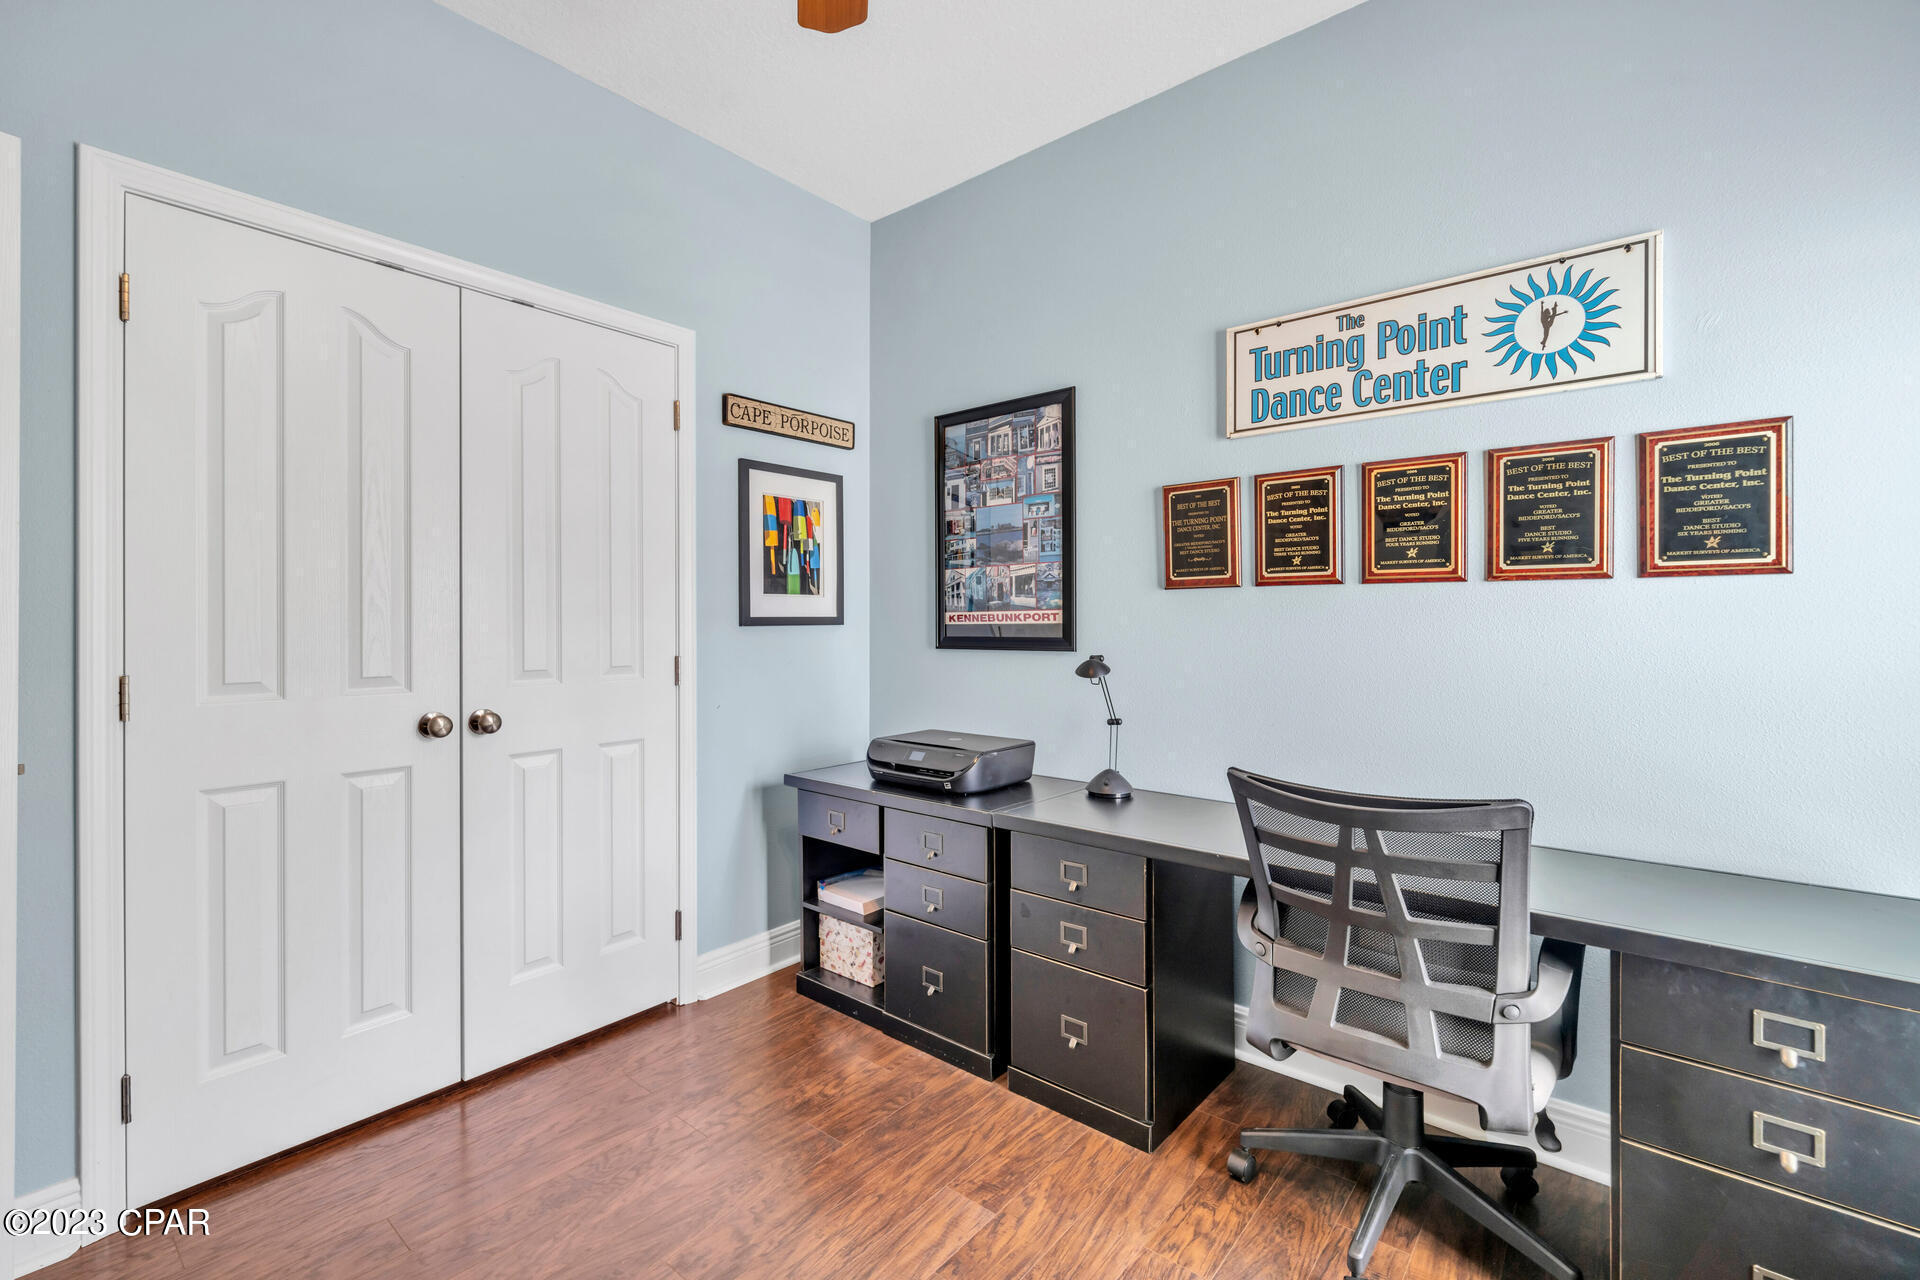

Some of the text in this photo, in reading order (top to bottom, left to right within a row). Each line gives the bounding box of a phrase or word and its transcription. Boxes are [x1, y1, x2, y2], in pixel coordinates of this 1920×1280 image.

[1336, 314, 1365, 332] The
[1249, 305, 1468, 383] Turning Point
[1251, 359, 1468, 423] Dance Center
[731, 402, 849, 442] CAPE PORPOISE
[1662, 446, 1767, 463] BEST OF THE BEST
[1507, 466, 1529, 475] BEST
[1685, 472, 1731, 481] Turning
[1735, 468, 1767, 477] Point
[1377, 479, 1396, 487] BEST
[1527, 483, 1563, 491] Turning
[949, 613, 1059, 622] KENNEBUNKPORT
